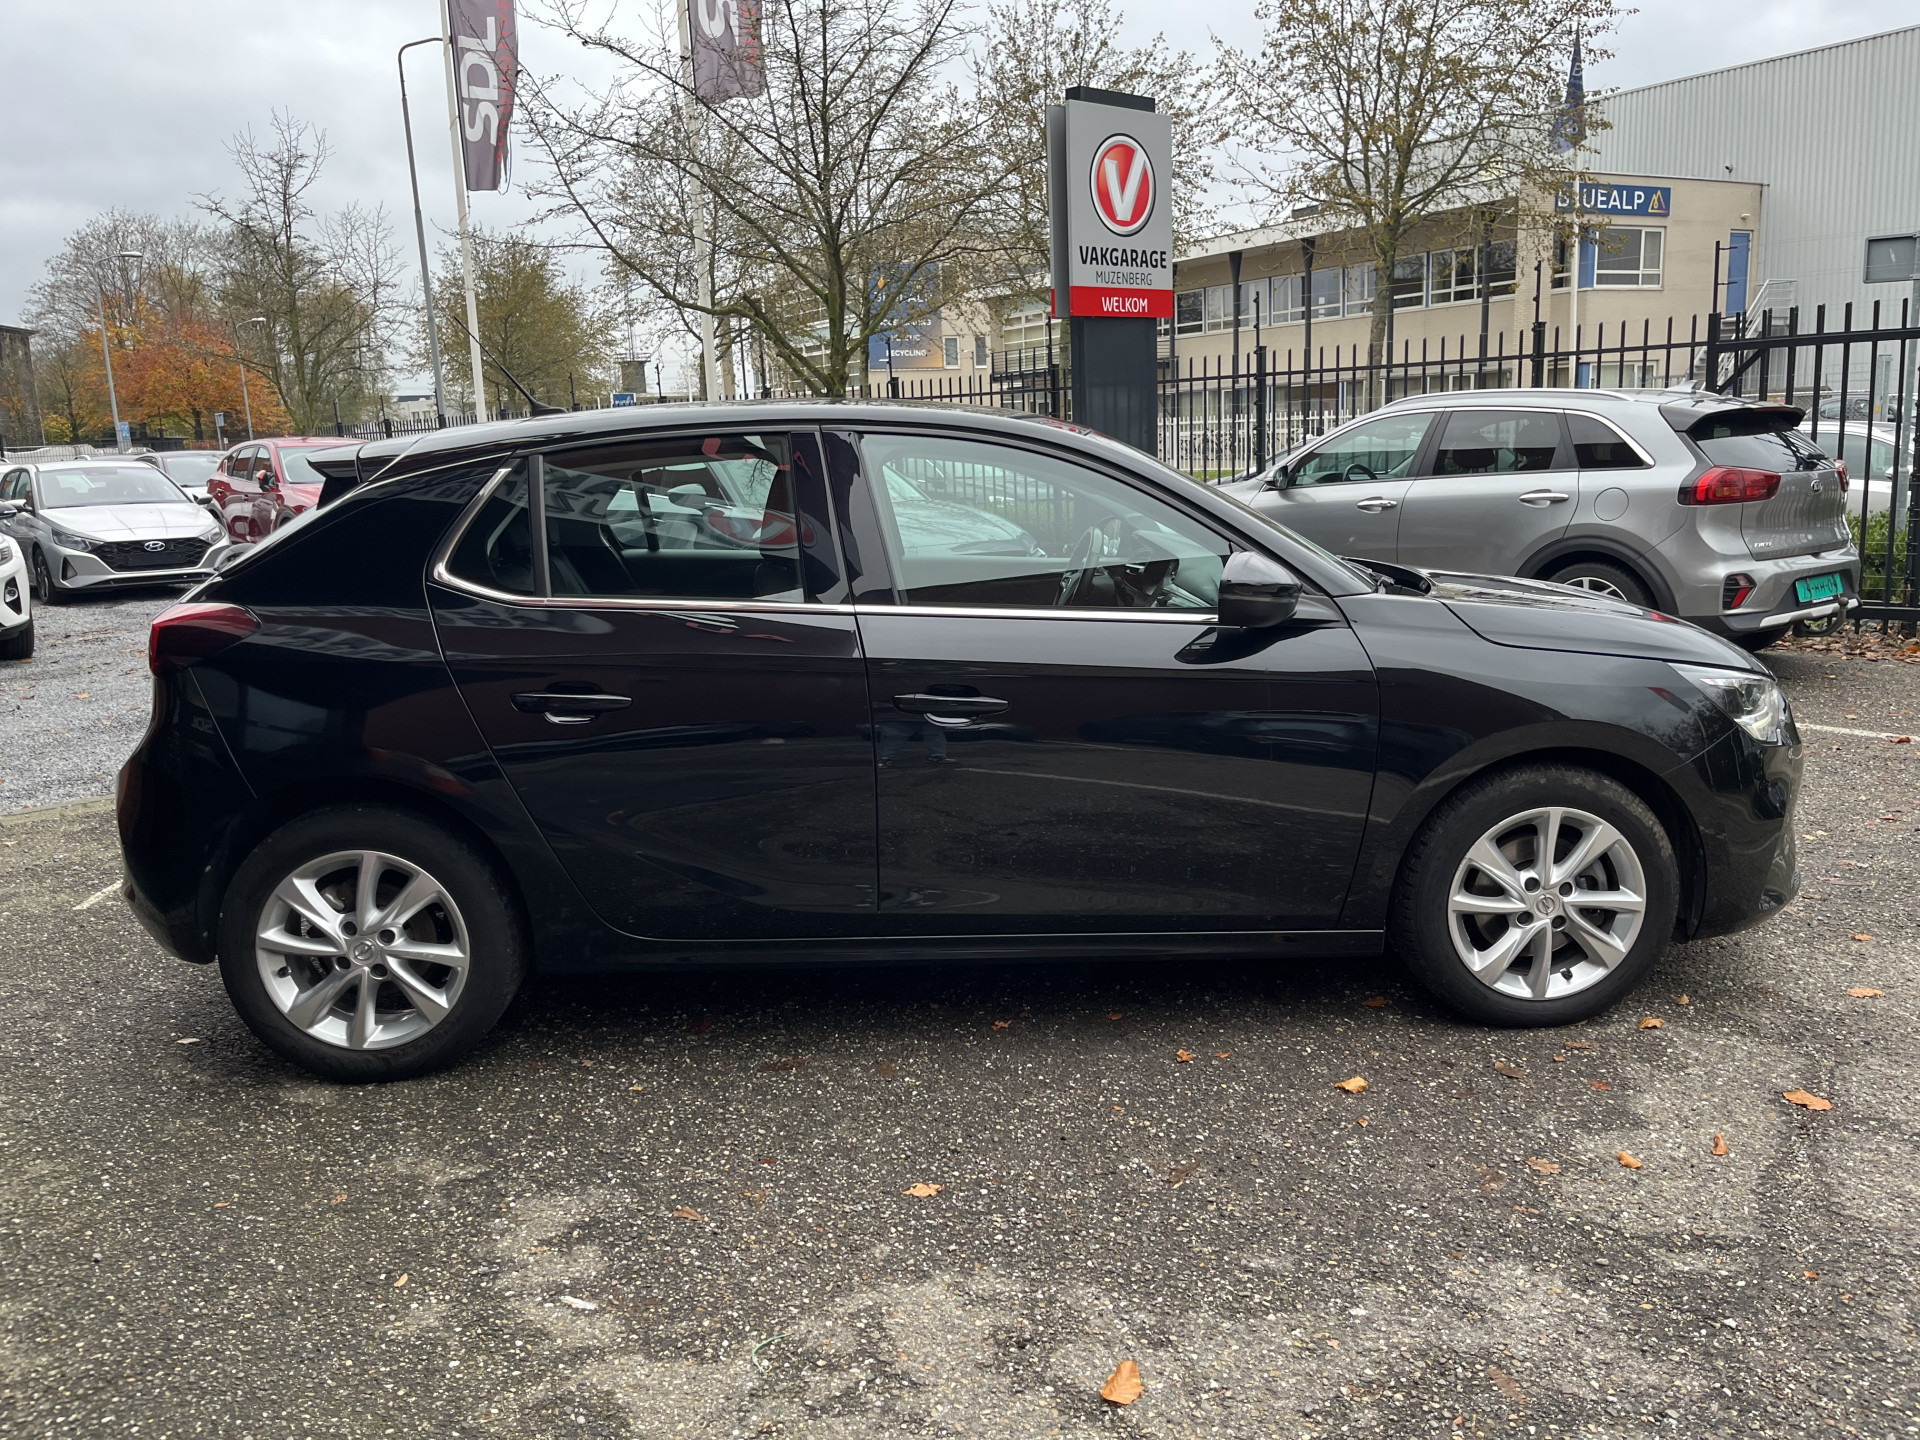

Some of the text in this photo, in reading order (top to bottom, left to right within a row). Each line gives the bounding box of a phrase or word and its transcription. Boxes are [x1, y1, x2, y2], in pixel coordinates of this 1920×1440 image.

[457, 16, 500, 147] SDL
[1557, 187, 1645, 210] BUEALP
[1079, 245, 1167, 269] VAKGARAGE
[1095, 270, 1152, 286] MUZENBERG
[1101, 296, 1148, 313] WELKOM
